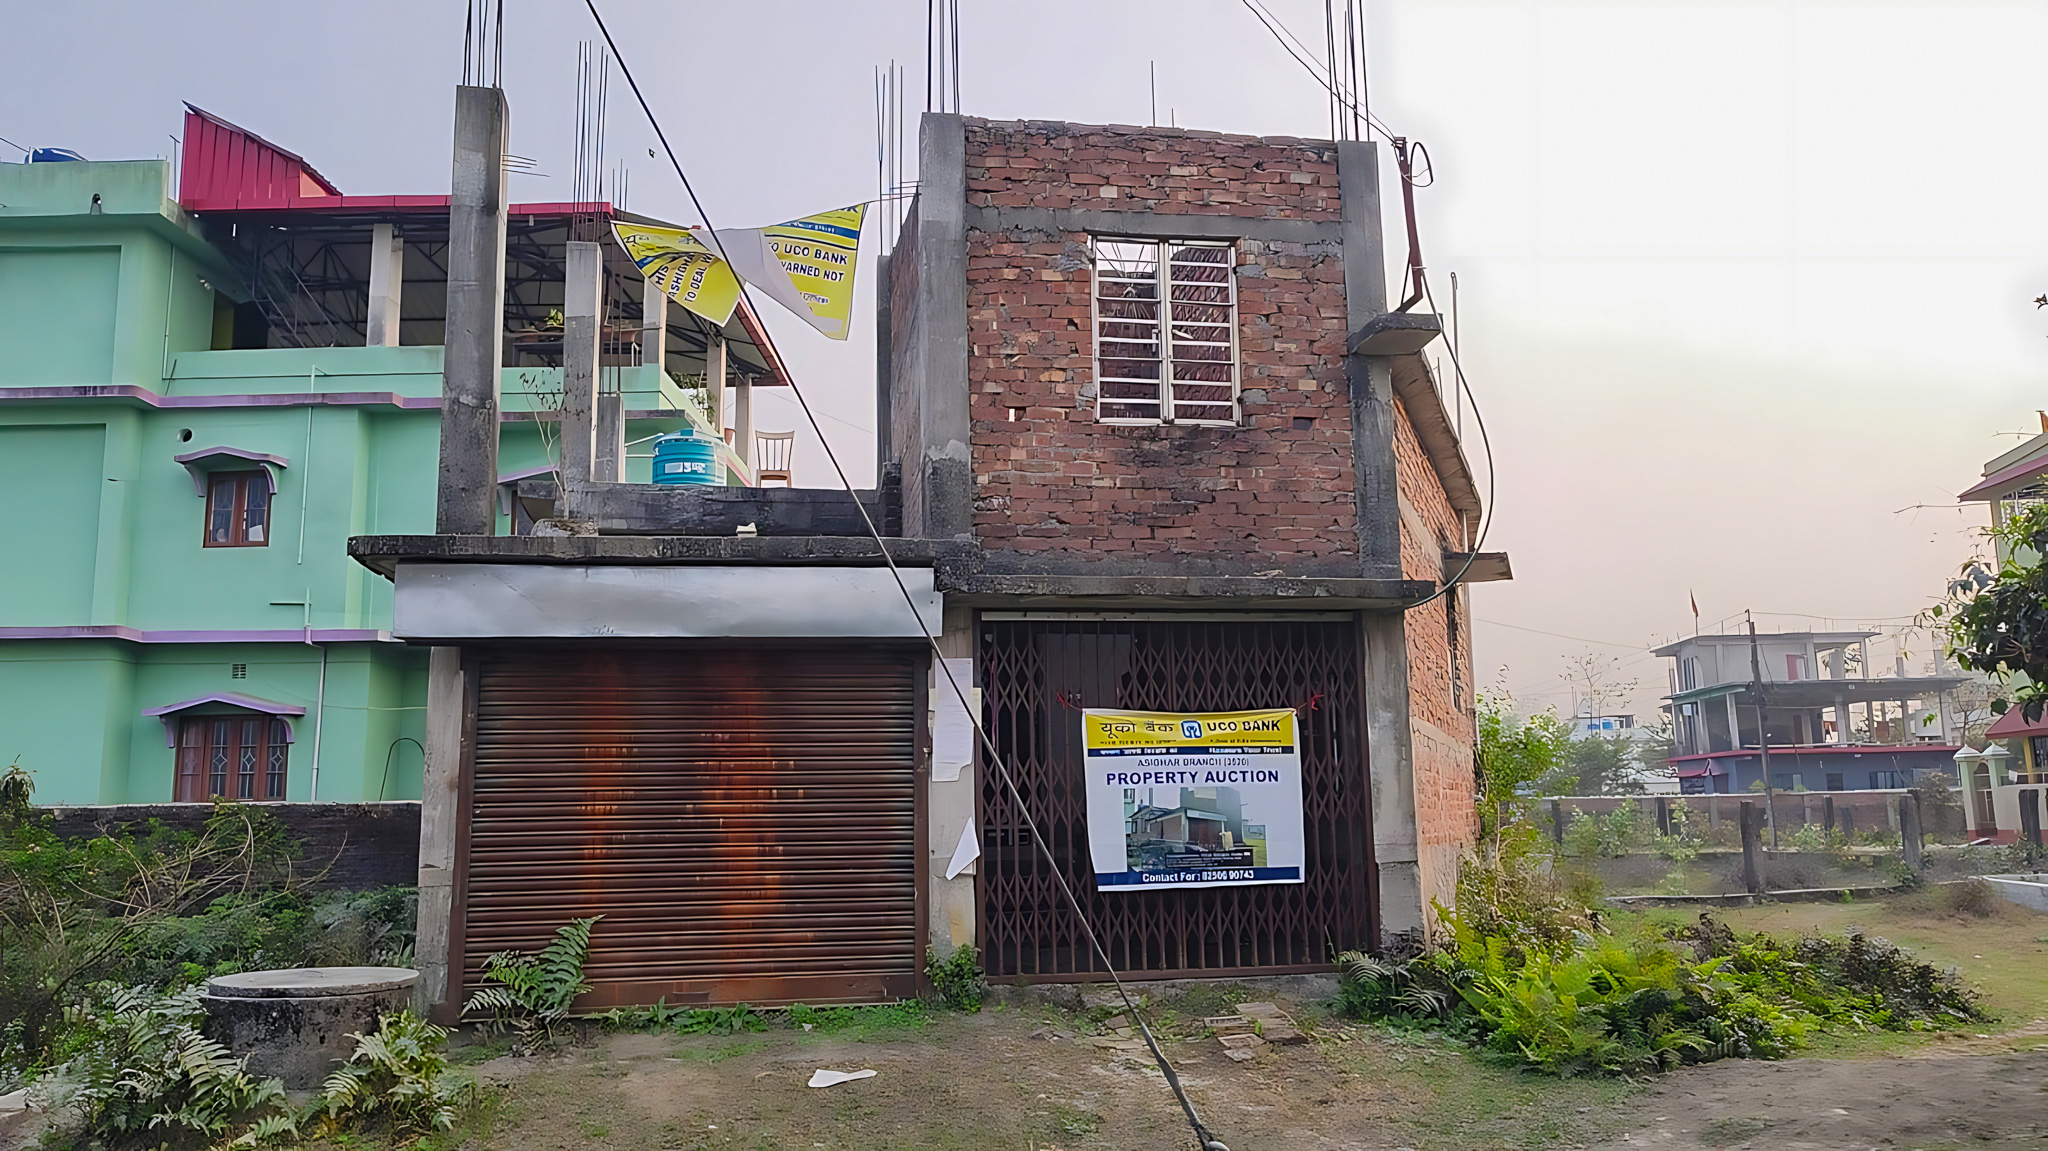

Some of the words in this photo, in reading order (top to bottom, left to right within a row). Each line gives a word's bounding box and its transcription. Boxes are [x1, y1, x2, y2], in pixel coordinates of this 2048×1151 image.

[784, 243, 810, 256] UCO
[814, 249, 848, 265] BANK
[690, 267, 707, 290] DEAL
[823, 270, 845, 282] NOT
[684, 291, 697, 303] TO
[1099, 721, 1137, 739] यूको
[1207, 721, 1238, 732] UCO
[1242, 720, 1281, 731] BANK
[1106, 771, 1198, 785] PROPERTY
[1204, 770, 1279, 783] AUCTION
[1142, 873, 1179, 882] Contact
